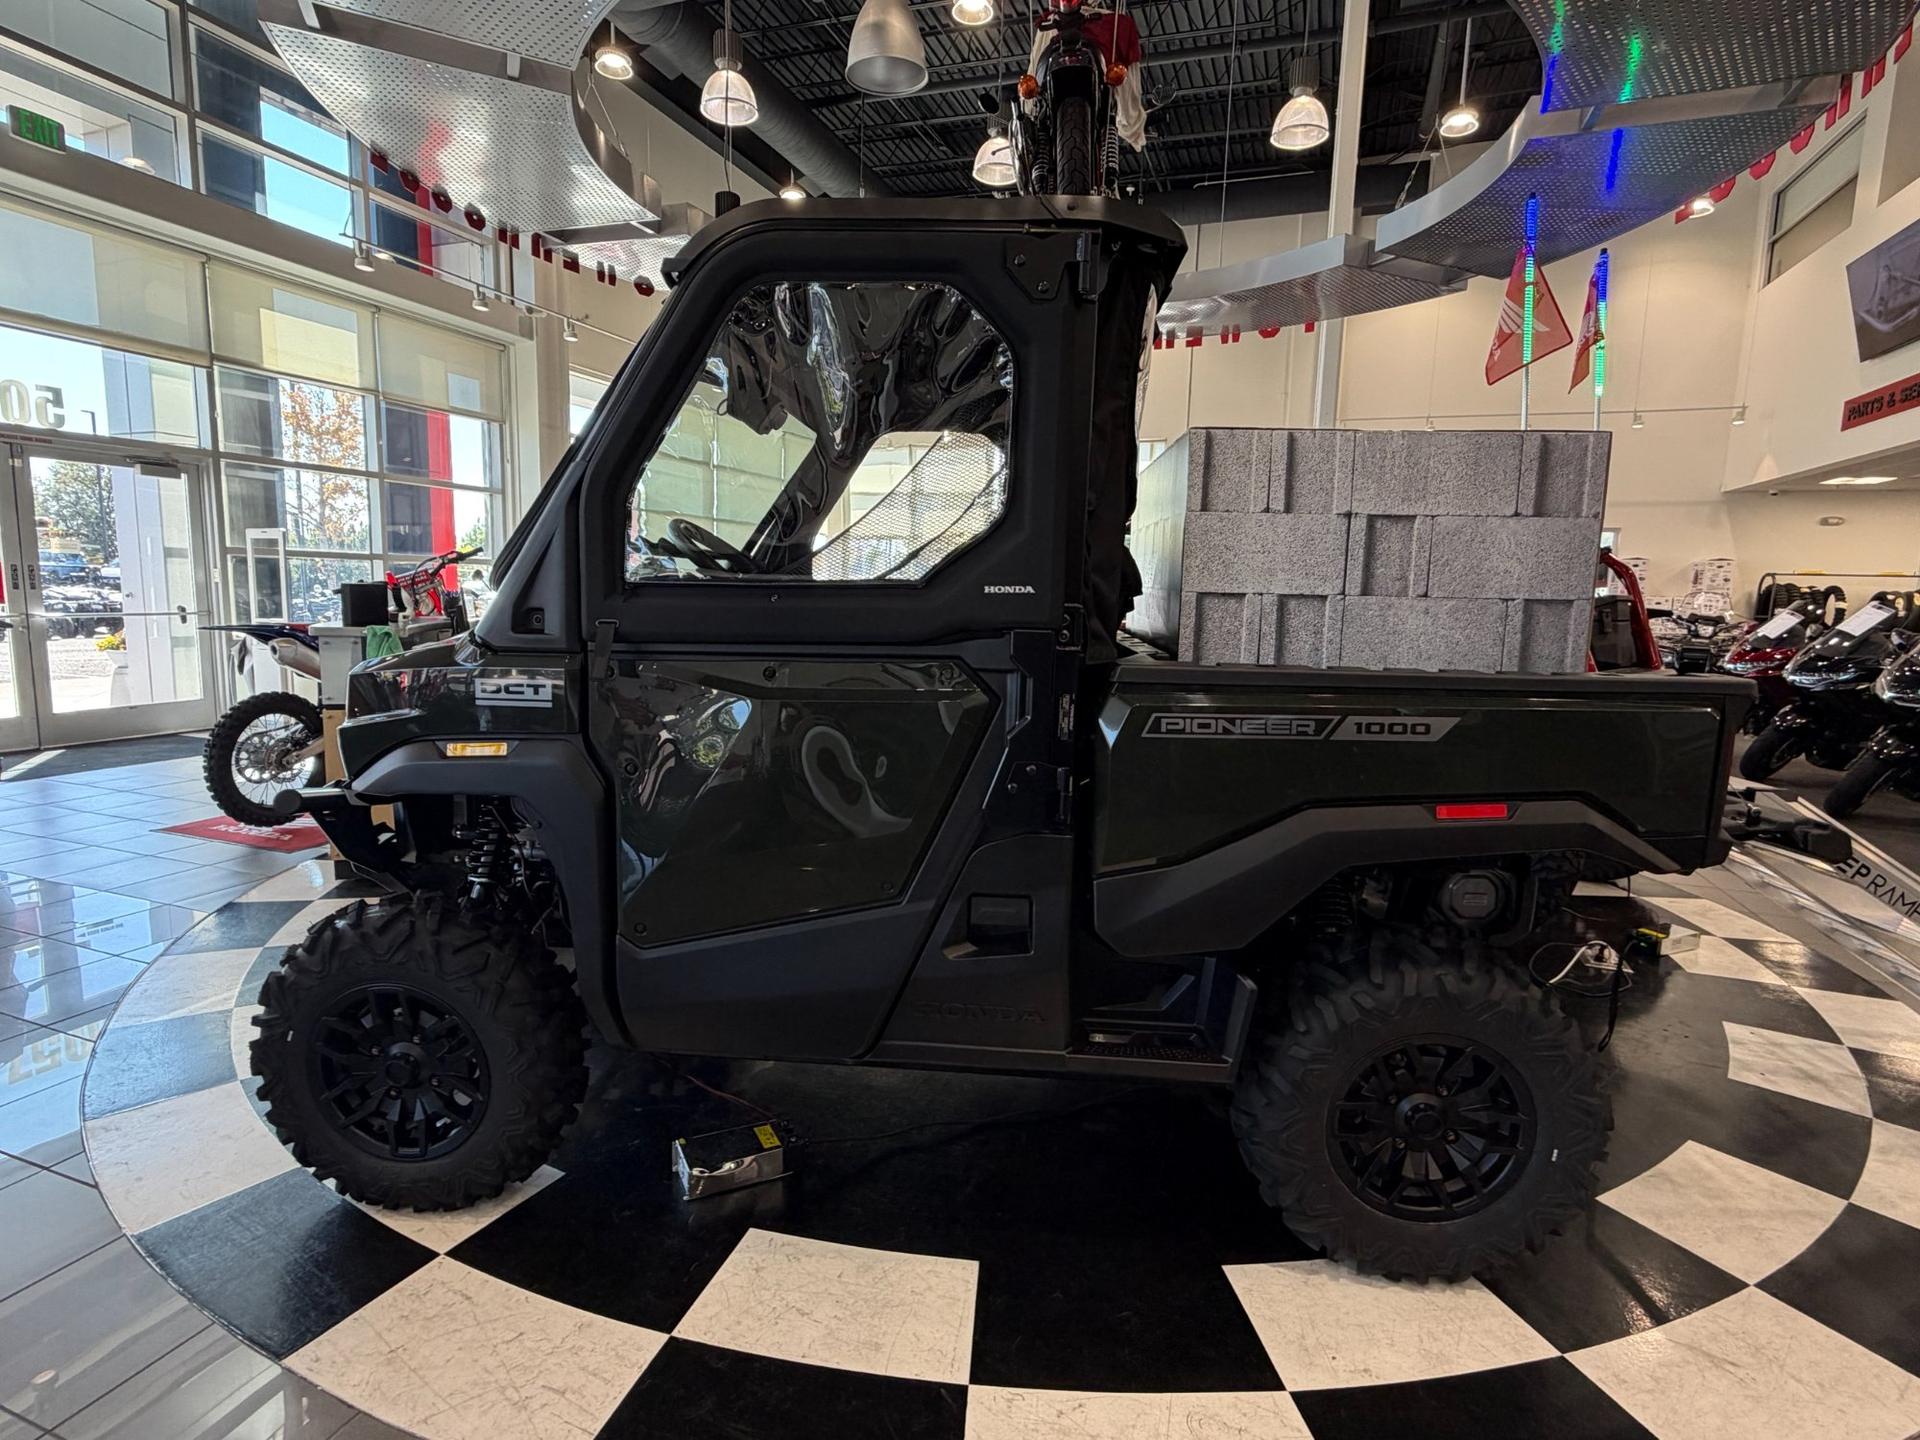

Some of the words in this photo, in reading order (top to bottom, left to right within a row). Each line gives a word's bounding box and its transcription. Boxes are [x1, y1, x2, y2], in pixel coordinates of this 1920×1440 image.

[18, 109, 59, 148] EXIT
[1847, 396, 1885, 421] PARTS
[1887, 391, 1896, 408] &
[984, 585, 1036, 594] HONDA
[480, 682, 547, 696] DCT
[1160, 717, 1315, 735] PIONEER
[1353, 721, 1431, 736] 1000
